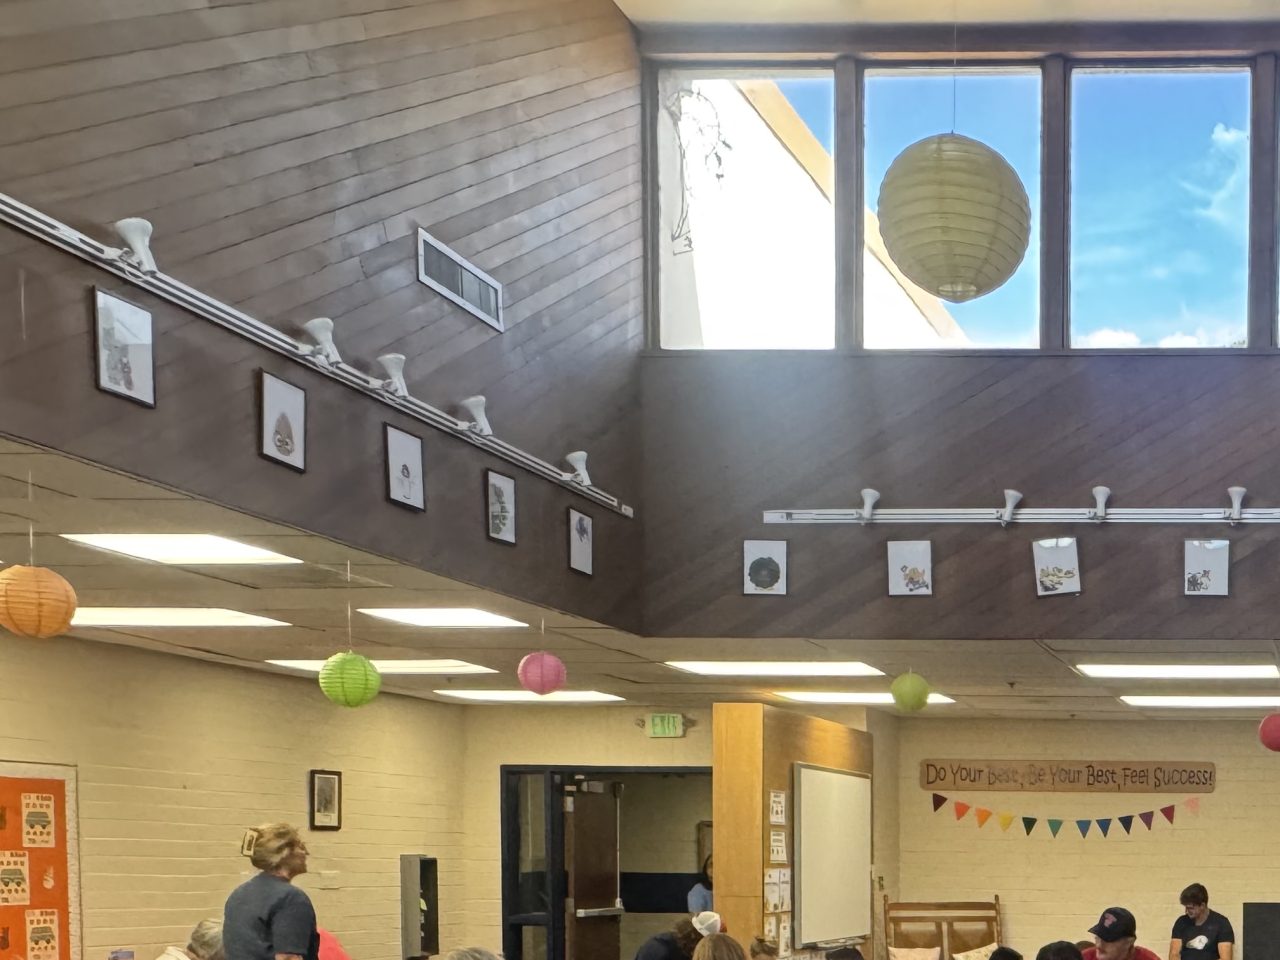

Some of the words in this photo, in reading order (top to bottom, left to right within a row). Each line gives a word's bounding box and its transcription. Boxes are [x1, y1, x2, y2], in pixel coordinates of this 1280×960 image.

[926, 764, 947, 784] Do
[1086, 765, 1120, 791] Best,
[1154, 767, 1212, 788] Success!
